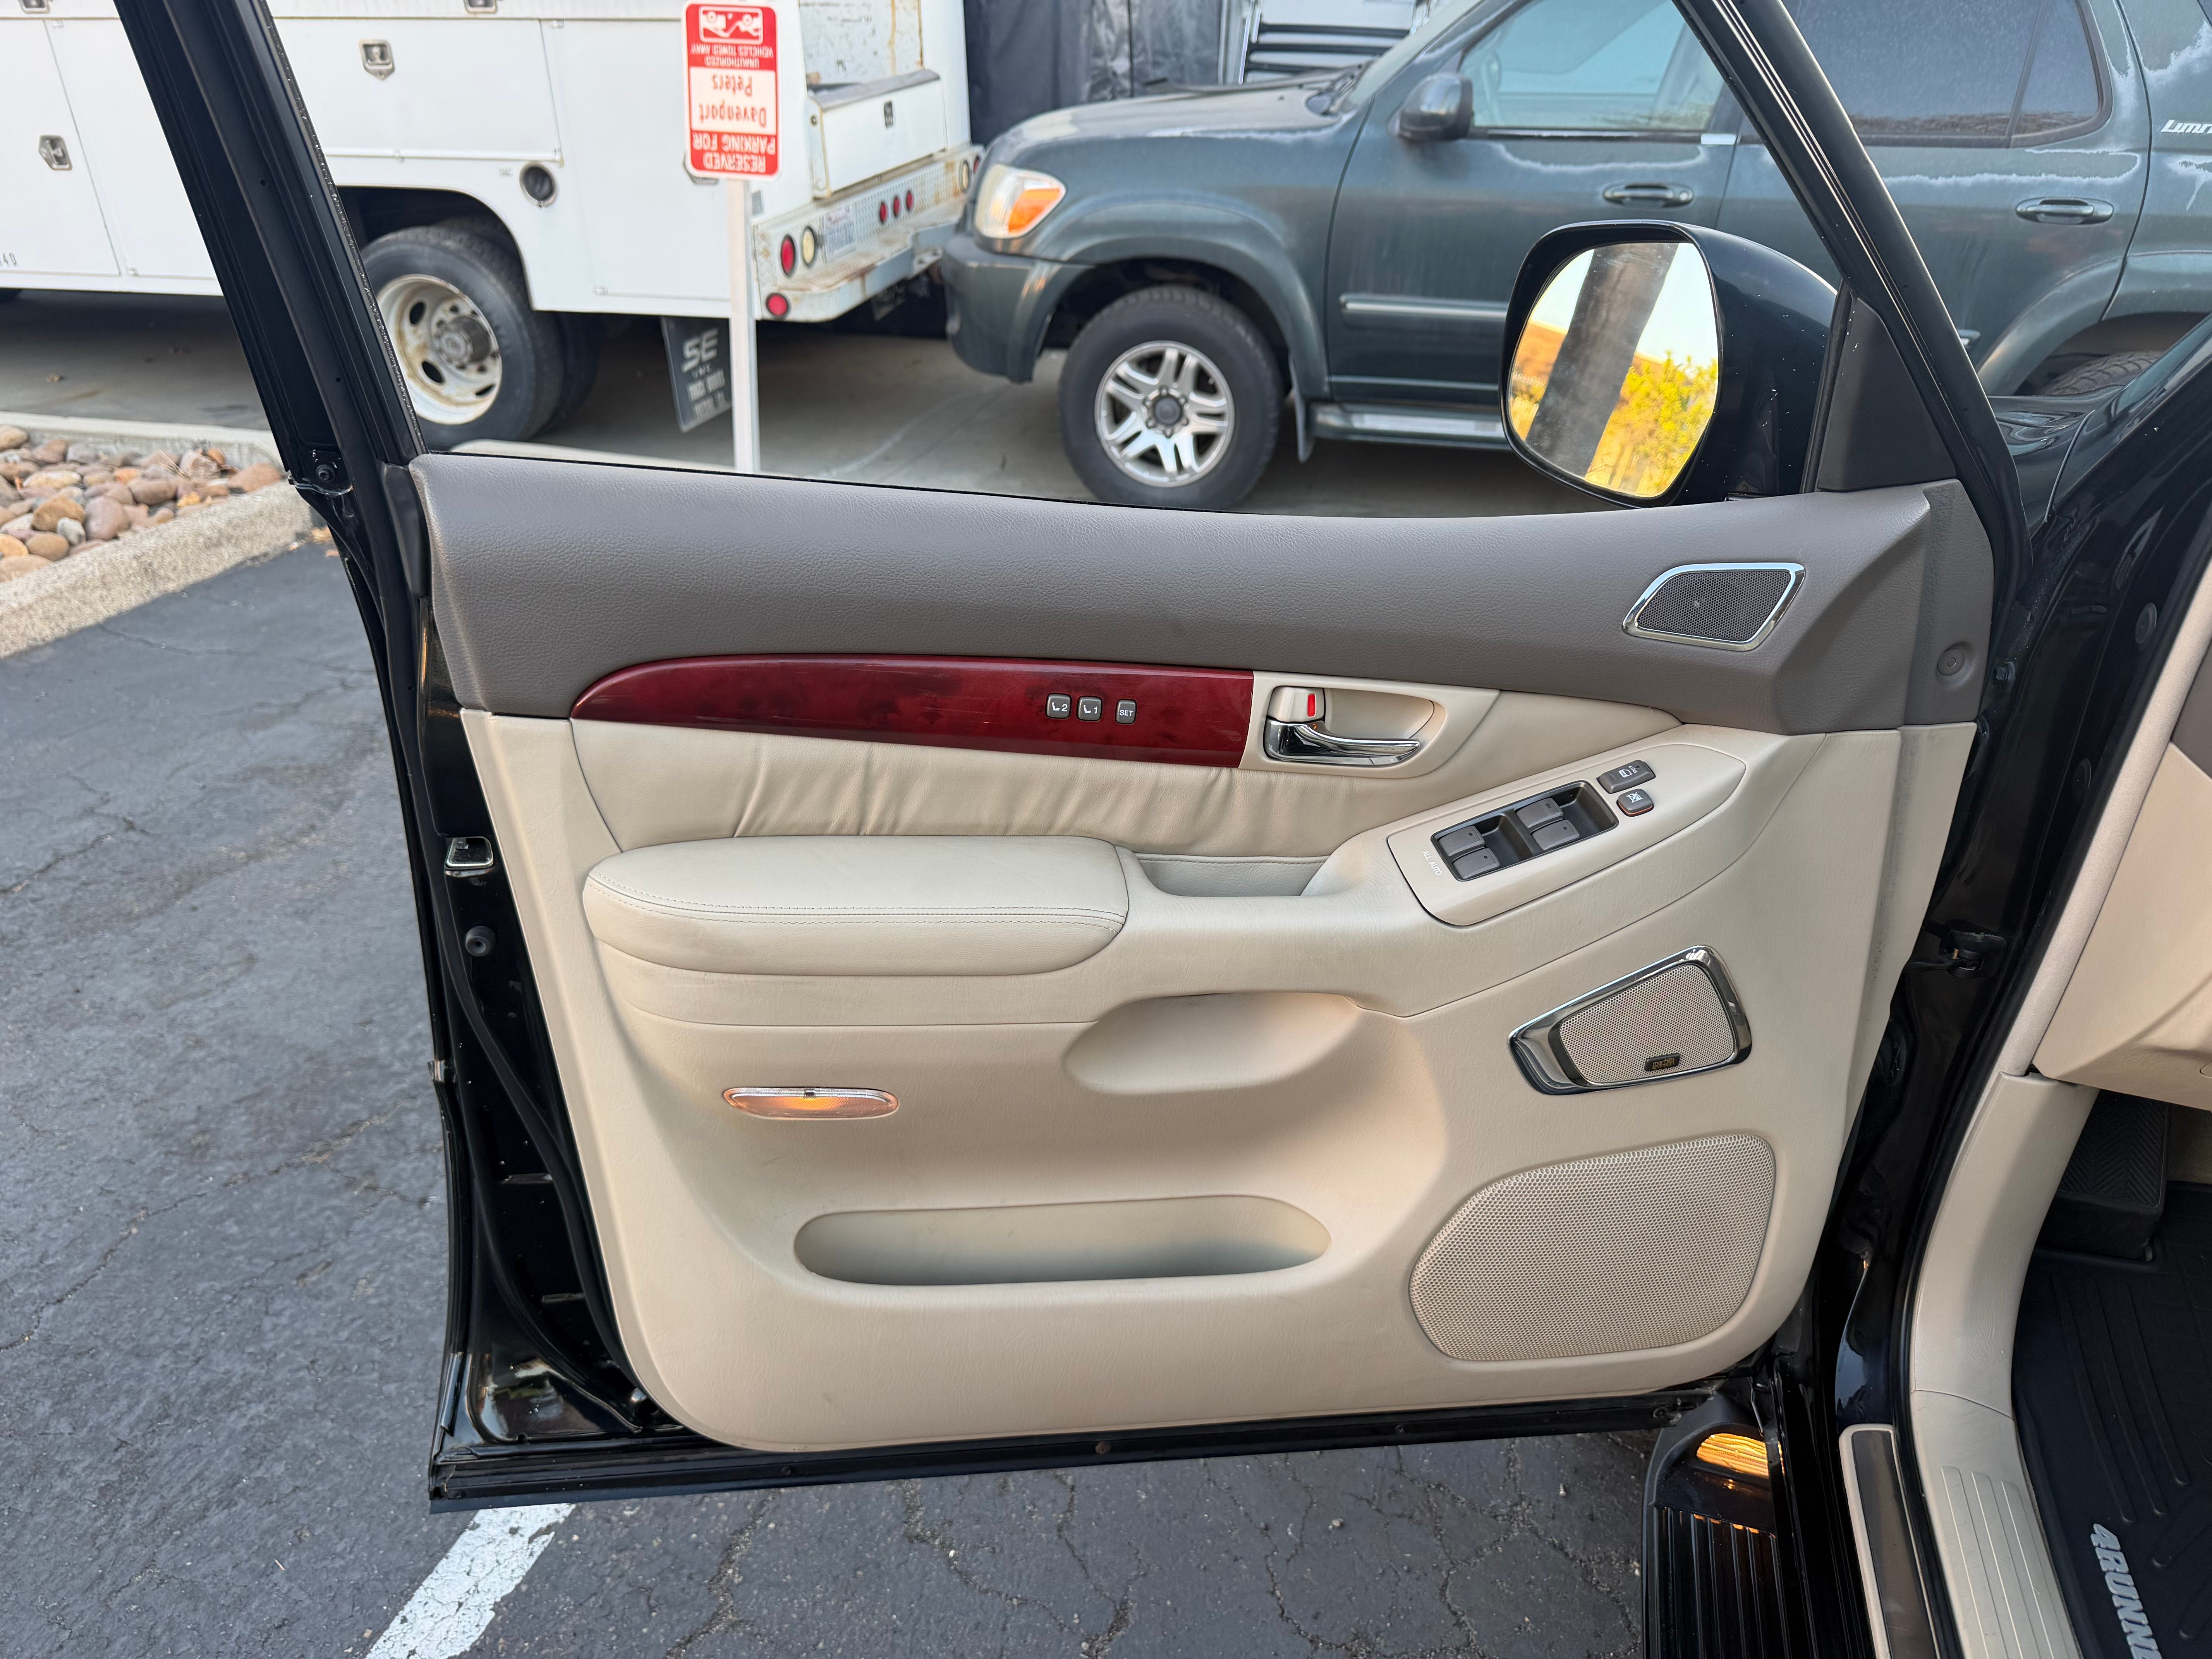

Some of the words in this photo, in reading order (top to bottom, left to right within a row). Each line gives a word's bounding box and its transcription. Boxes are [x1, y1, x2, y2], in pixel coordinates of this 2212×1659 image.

[691, 43, 711, 54] AWAY
[712, 45, 737, 55] TOWED
[738, 45, 774, 58] VEHICLES
[704, 56, 759, 69] UNAUTHORIZED
[712, 74, 752, 97] Peters
[699, 100, 767, 128] Davenport
[692, 132, 717, 151] FOR
[722, 135, 775, 155] PARKING
[704, 153, 766, 172] RESERVED
[1094, 706, 1098, 714] 1
[1422, 851, 1432, 861] ALL
[1428, 861, 1442, 875] AUTO
